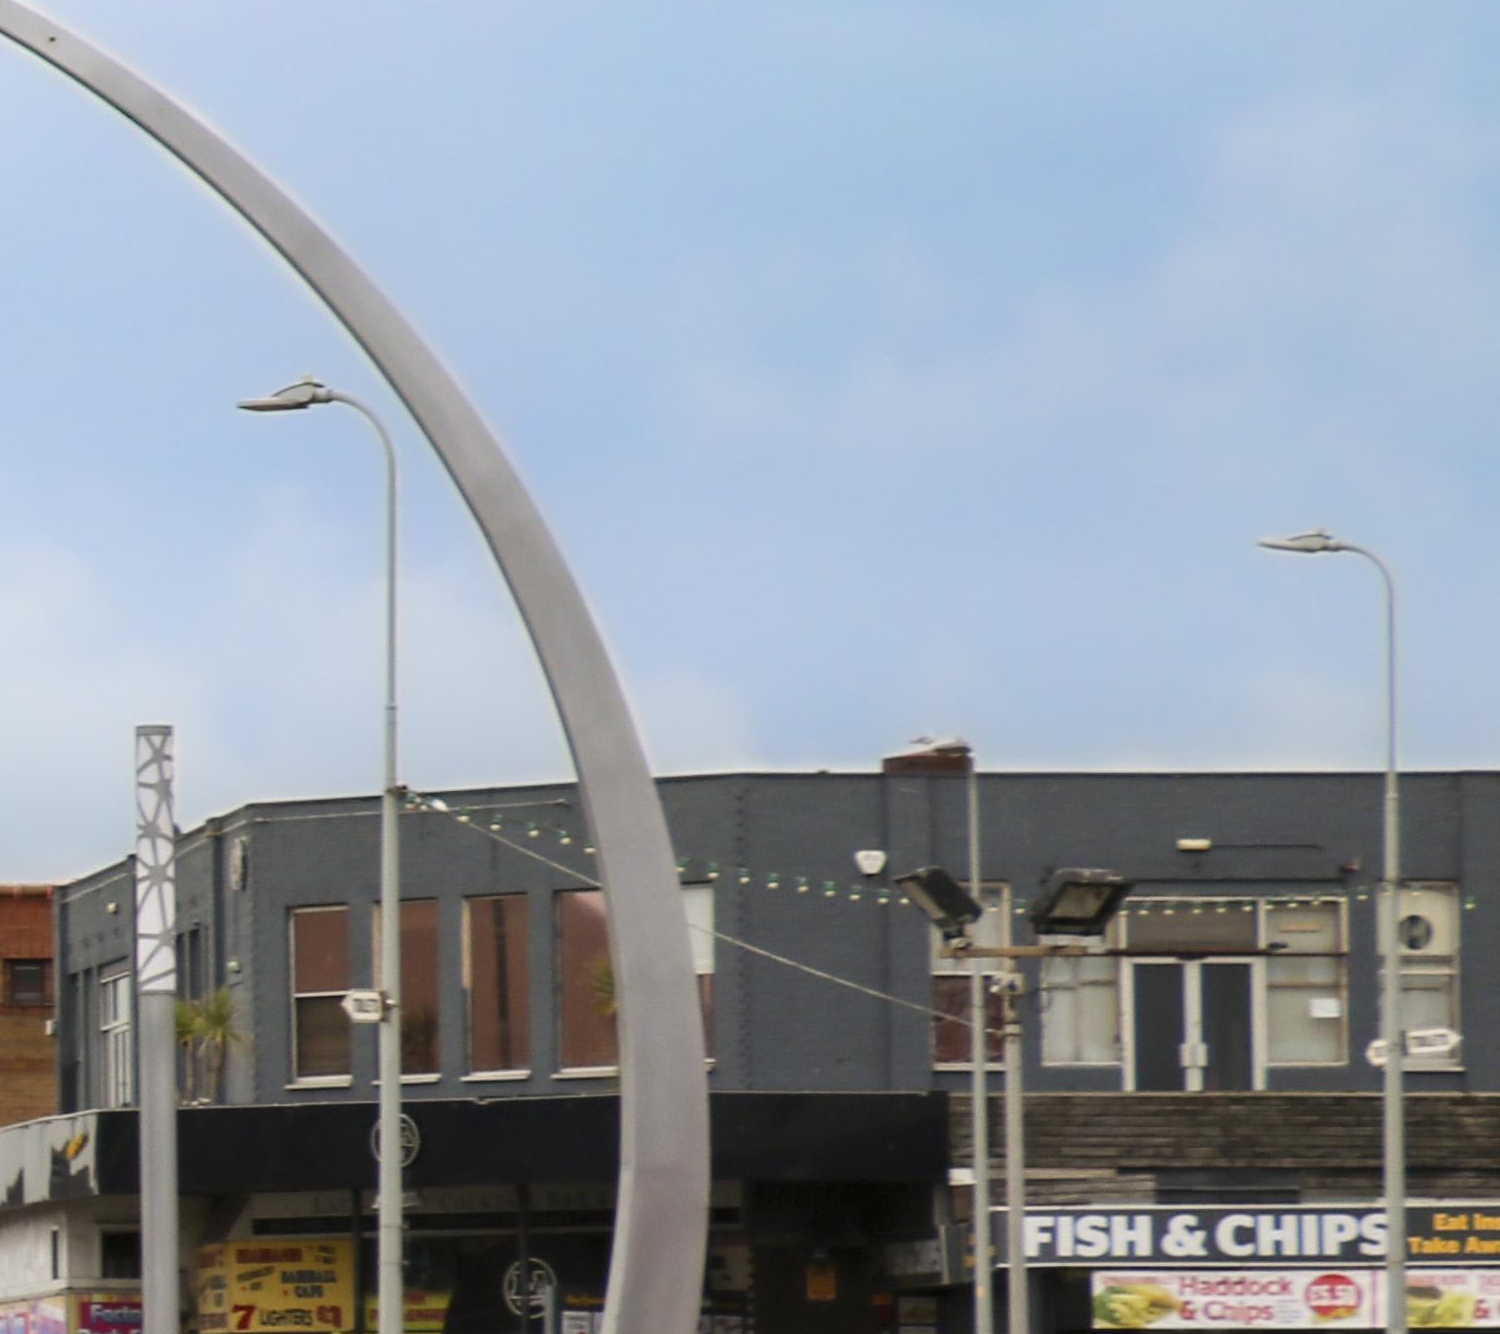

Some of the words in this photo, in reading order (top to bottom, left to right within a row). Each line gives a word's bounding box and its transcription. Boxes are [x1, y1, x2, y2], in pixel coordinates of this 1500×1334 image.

[1432, 1213, 1469, 1231] Eat
[1023, 1213, 1153, 1257] FISH
[1160, 1213, 1208, 1257] &
[1214, 1213, 1388, 1257] CHIPS
[1407, 1236, 1462, 1254] Take
[1179, 1275, 1293, 1296] Haddock
